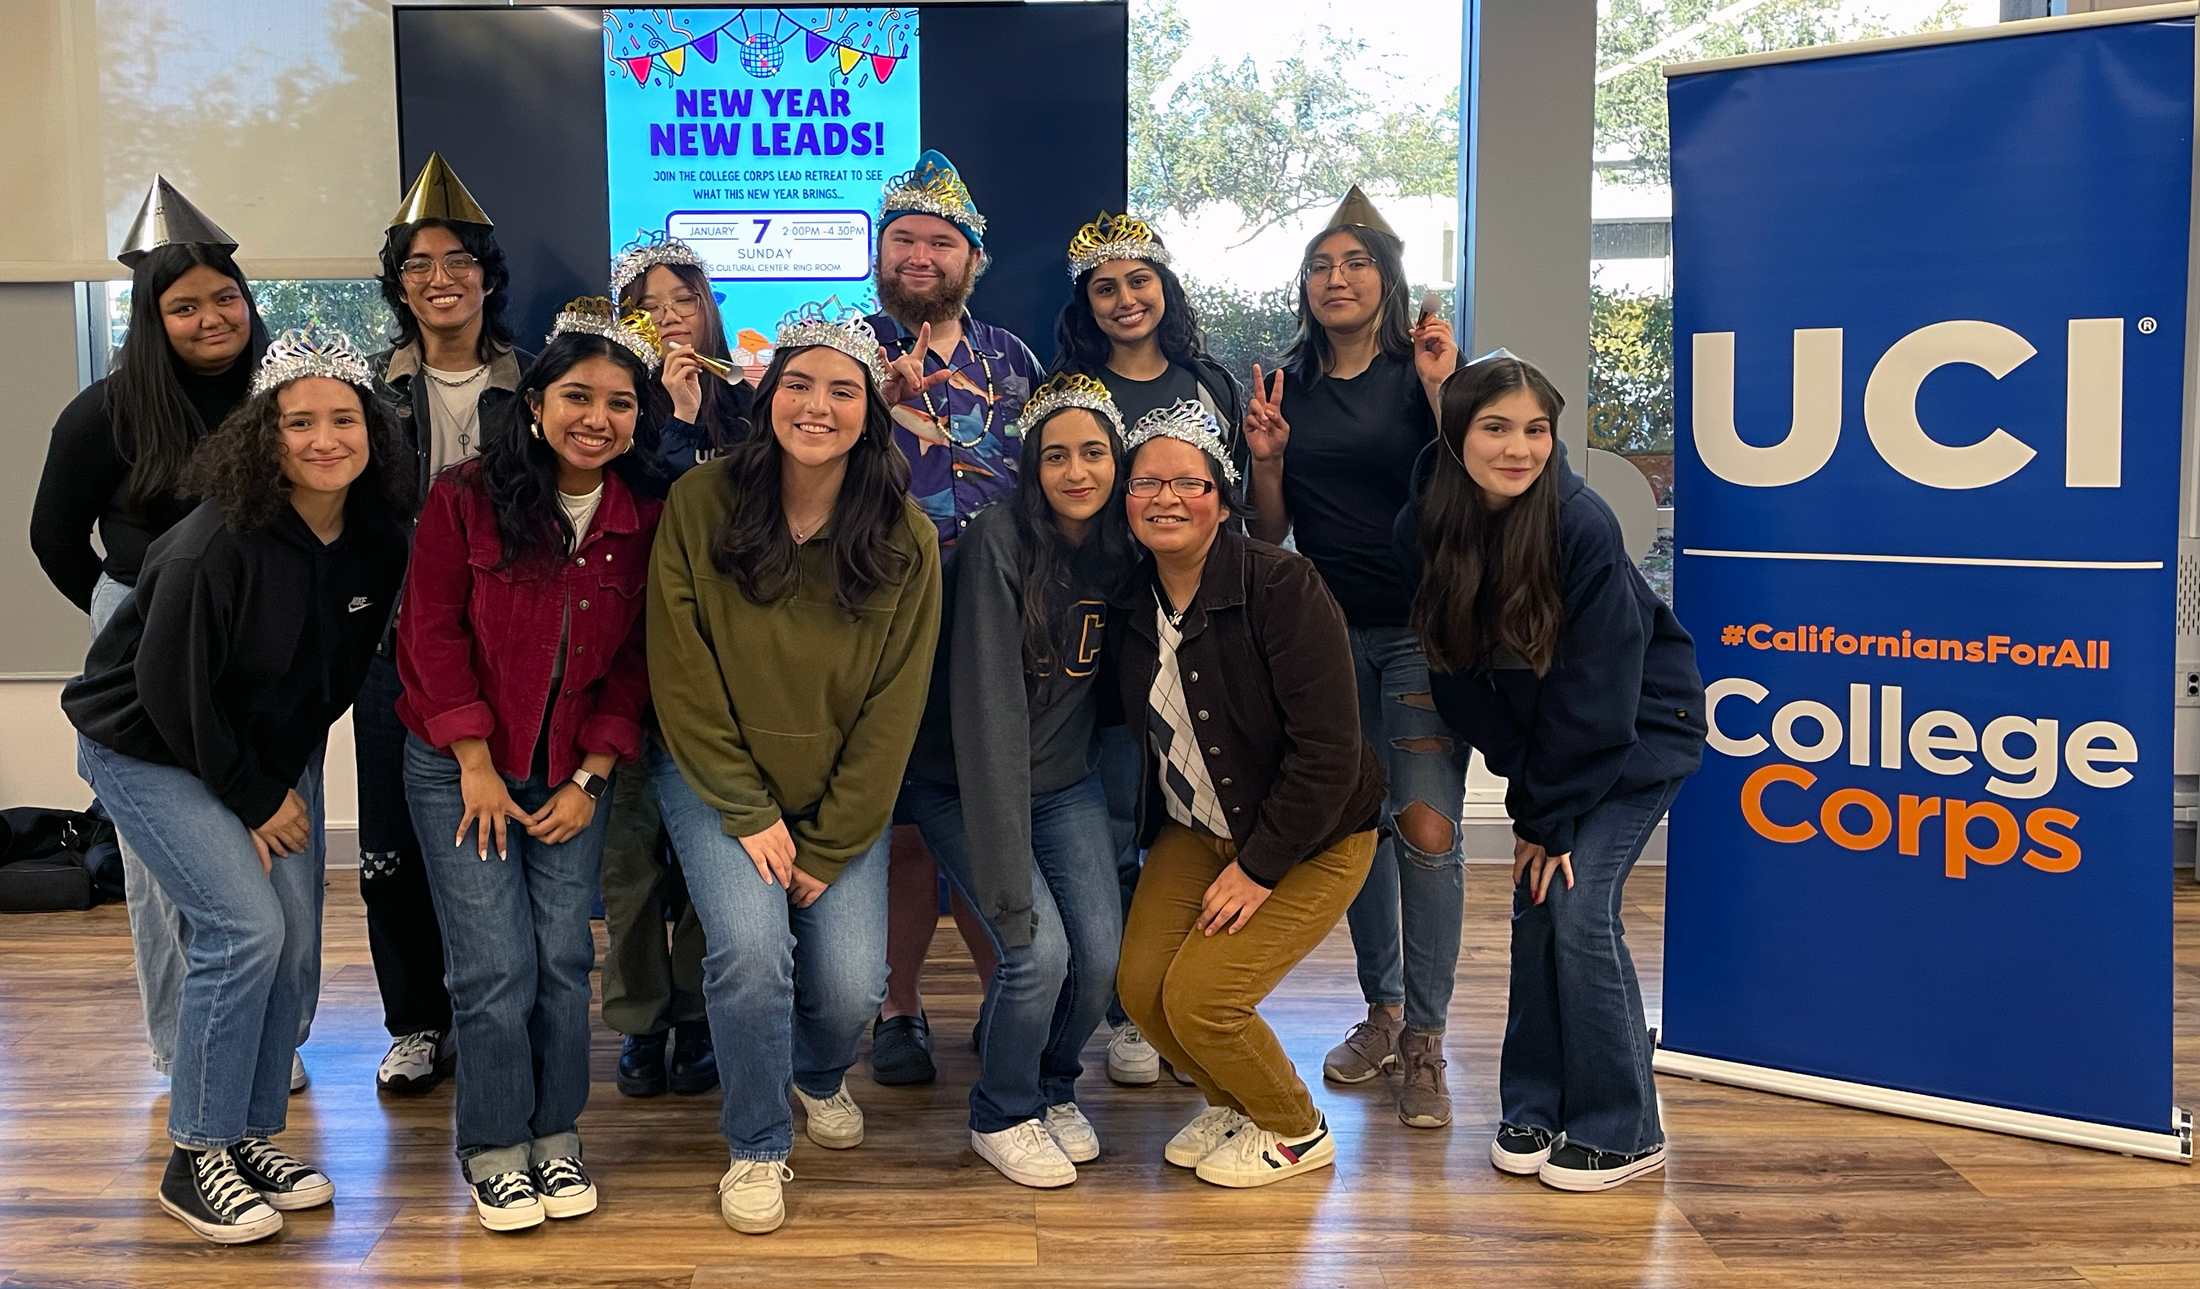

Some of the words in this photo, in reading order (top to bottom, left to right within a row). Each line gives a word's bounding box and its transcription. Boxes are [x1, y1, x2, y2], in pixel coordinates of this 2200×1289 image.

[676, 89, 753, 118] NEW
[761, 88, 851, 118] YEAR
[650, 123, 741, 157] NEW
[752, 121, 885, 157] LEADS!
[653, 171, 676, 182] JOIN
[679, 171, 696, 181] THE
[699, 171, 741, 182] COLLEGE
[744, 170, 775, 182] CORPS
[778, 170, 802, 181] LEAD
[805, 170, 848, 181] RETREAT
[850, 170, 863, 181] TO
[865, 170, 883, 181] SEE
[693, 189, 721, 200] WHAT
[724, 189, 744, 200] THIS
[747, 189, 770, 199] NEW
[773, 189, 799, 199] YEAR
[689, 226, 736, 236] JANUARY
[753, 219, 772, 244] 7
[782, 225, 820, 236] 2:00PM
[737, 248, 794, 259] SUNDAY
[716, 263, 756, 272] CULTURAL
[758, 263, 791, 272] CENTER:
[793, 263, 813, 272] RING
[815, 263, 842, 272] ROOM
[1692, 317, 2124, 490] UCI
[1721, 622, 2110, 669] #CaliforniansForAll
[1703, 677, 2139, 799] College
[1740, 763, 2082, 879] Corps
